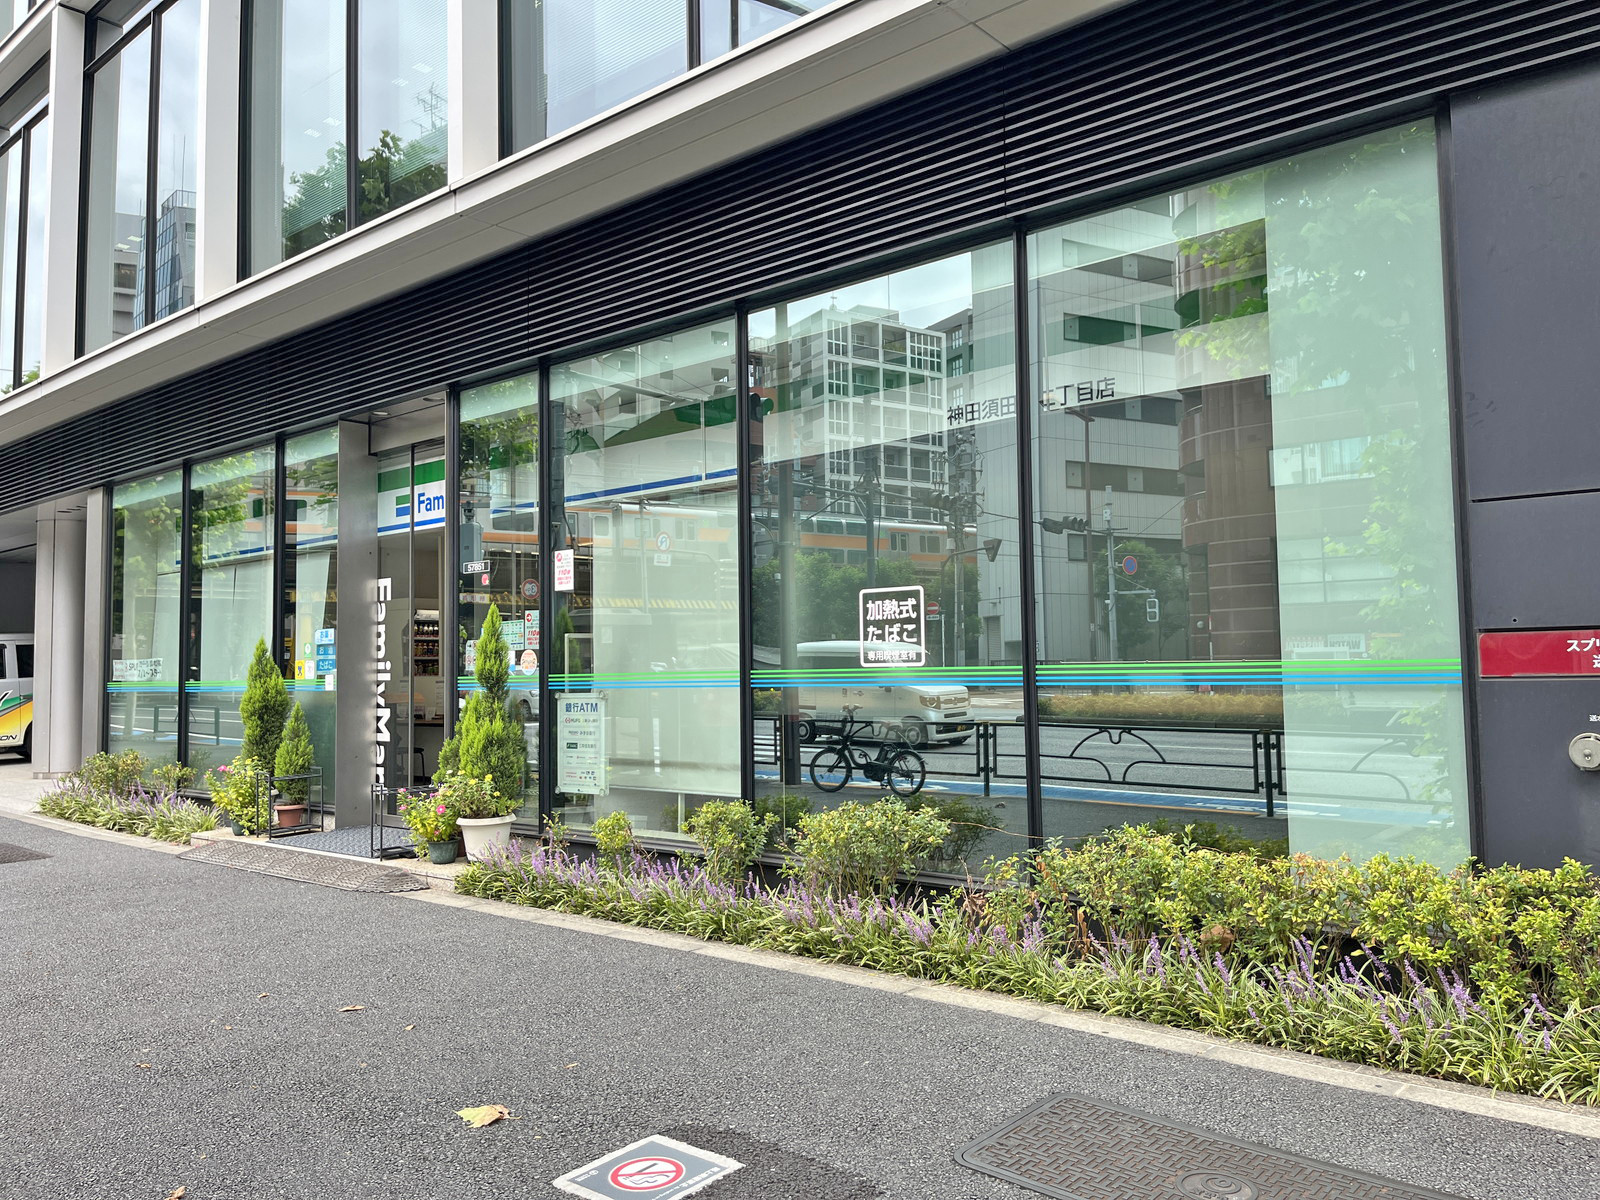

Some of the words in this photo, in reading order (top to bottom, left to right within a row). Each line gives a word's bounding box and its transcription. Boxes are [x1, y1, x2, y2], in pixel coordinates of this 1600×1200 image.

[418, 492, 444, 514] Fam
[866, 597, 917, 620] 加熱式
[867, 623, 917, 643] たばこ
[565, 702, 598, 713] 銀行ATM
